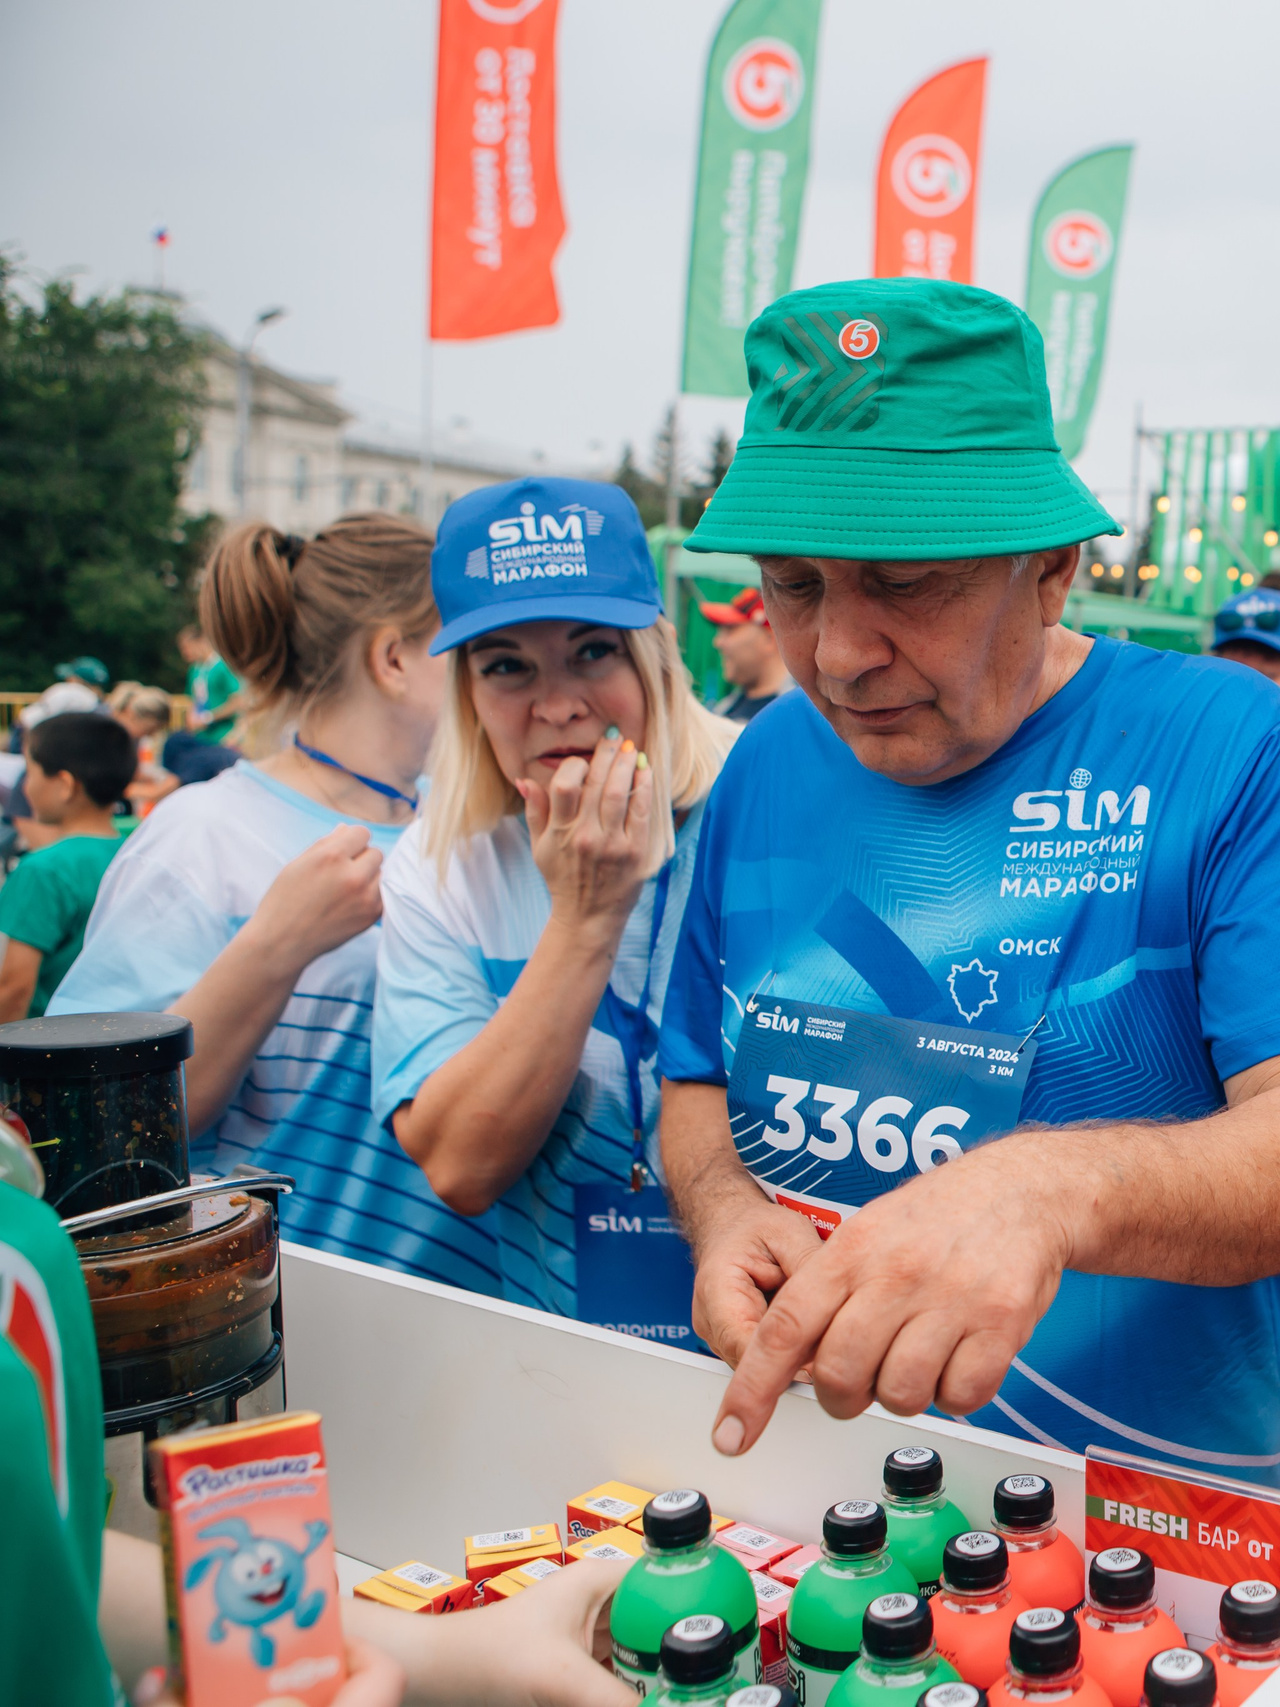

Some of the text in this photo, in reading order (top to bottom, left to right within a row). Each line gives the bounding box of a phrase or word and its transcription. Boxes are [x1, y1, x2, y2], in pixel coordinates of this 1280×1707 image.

[490, 541, 586, 563] СИБИРСКИЙ
[493, 563, 588, 586] МАРАФОН
[1005, 830, 1145, 860] СИБИРСКИЙ
[1002, 853, 1141, 877] МЕЖДУНАРОДНЫЙ
[1000, 870, 1138, 899] МАРАФОН
[998, 936, 1062, 957] ОМСК
[806, 1016, 846, 1030] СИБИРСКИЙ
[803, 1028, 843, 1042] МАРАФОН
[916, 1036, 1019, 1064] 3 АВГУСТА 2024
[988, 1064, 1015, 1078] 3 КМ
[761, 1074, 971, 1174] 3366
[810, 1213, 836, 1232] Банк
[1103, 1498, 1189, 1541] FRESH
[1197, 1521, 1240, 1552] БАР
